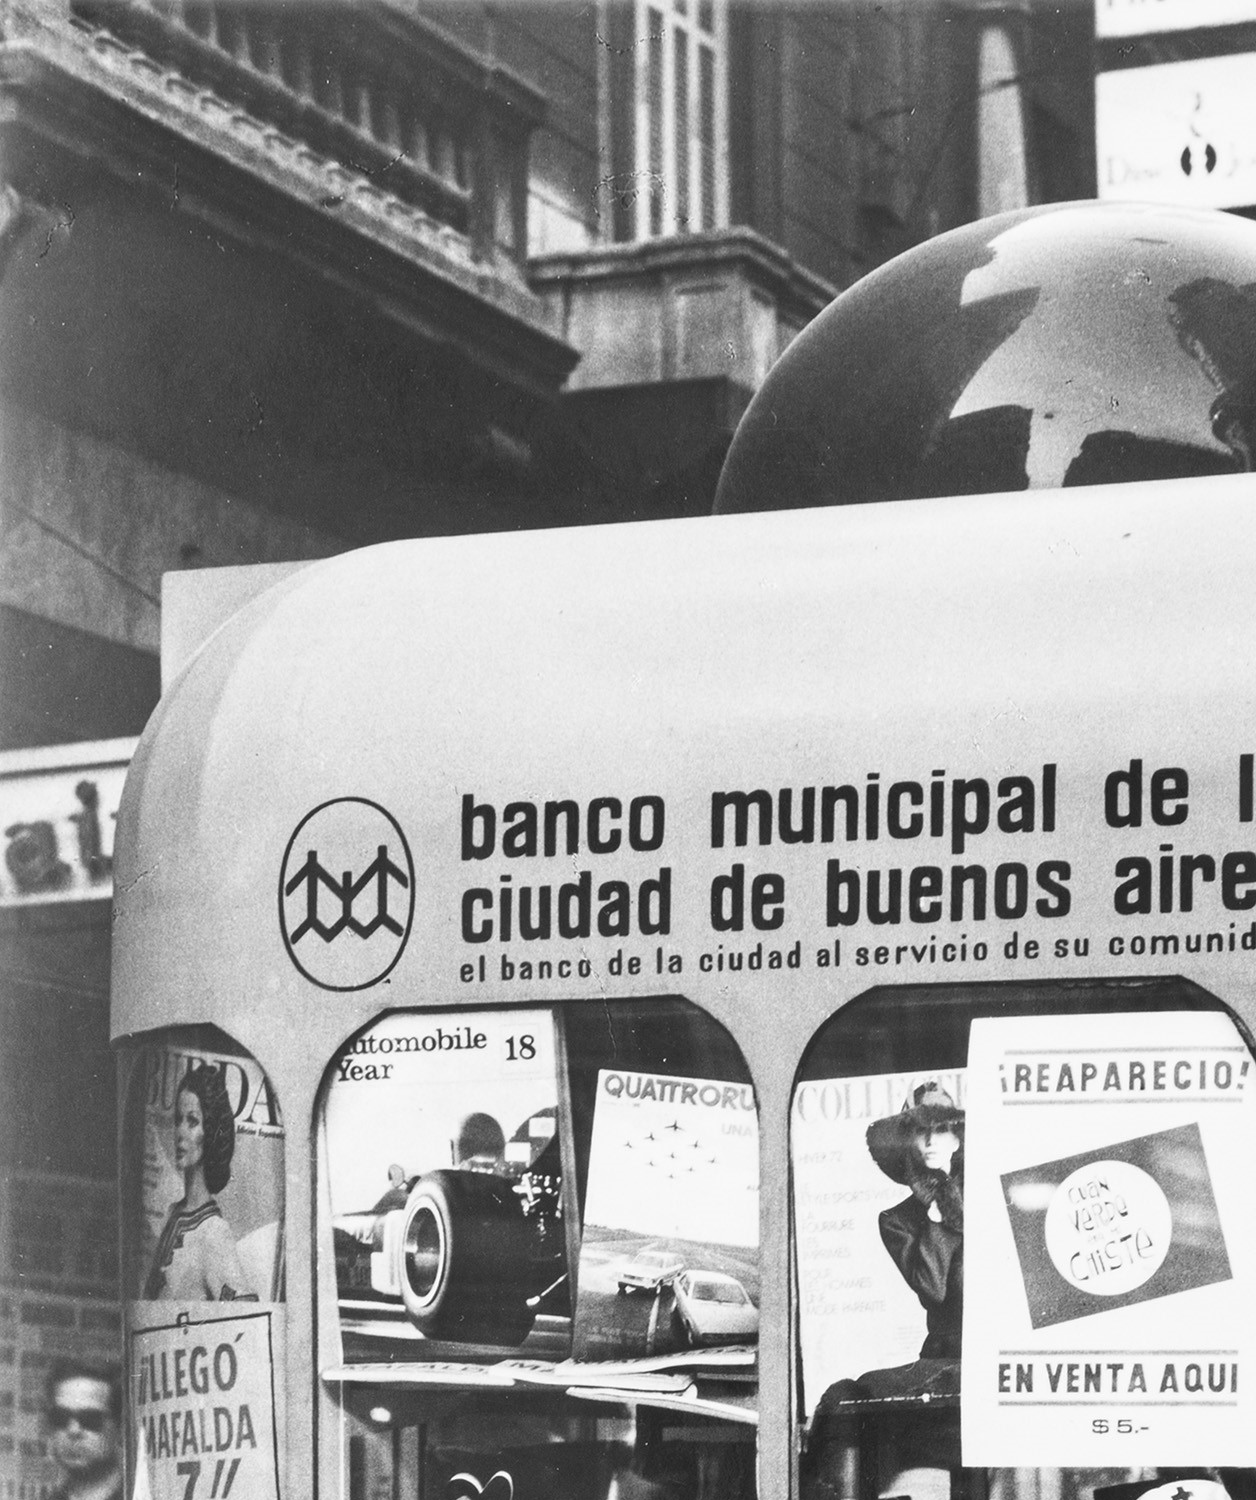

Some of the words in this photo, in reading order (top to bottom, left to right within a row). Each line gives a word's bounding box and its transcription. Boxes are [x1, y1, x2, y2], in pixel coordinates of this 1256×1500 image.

[461, 793, 666, 861] banco
[711, 763, 1057, 855] municipal
[1104, 758, 1190, 828] de
[461, 866, 672, 943] ciudad
[711, 863, 785, 932] de
[827, 858, 1072, 927] buenos
[460, 955, 486, 983] el
[500, 953, 592, 981] banco
[608, 949, 642, 976] de
[657, 946, 683, 974] la
[699, 940, 801, 973] ciudad
[816, 940, 840, 968] al
[855, 934, 988, 967] servicio
[1004, 931, 1040, 960] de
[1054, 934, 1090, 958] su
[506, 1035, 536, 1061] 18
[338, 1059, 394, 1082] Year
[999, 1060, 1251, 1094] ¡REAPARECIO!
[604, 1073, 755, 1111] QUATTRORU
[998, 1363, 1034, 1394] EN
[1046, 1362, 1149, 1394] VENTA
[1160, 1362, 1239, 1394] AQUI
